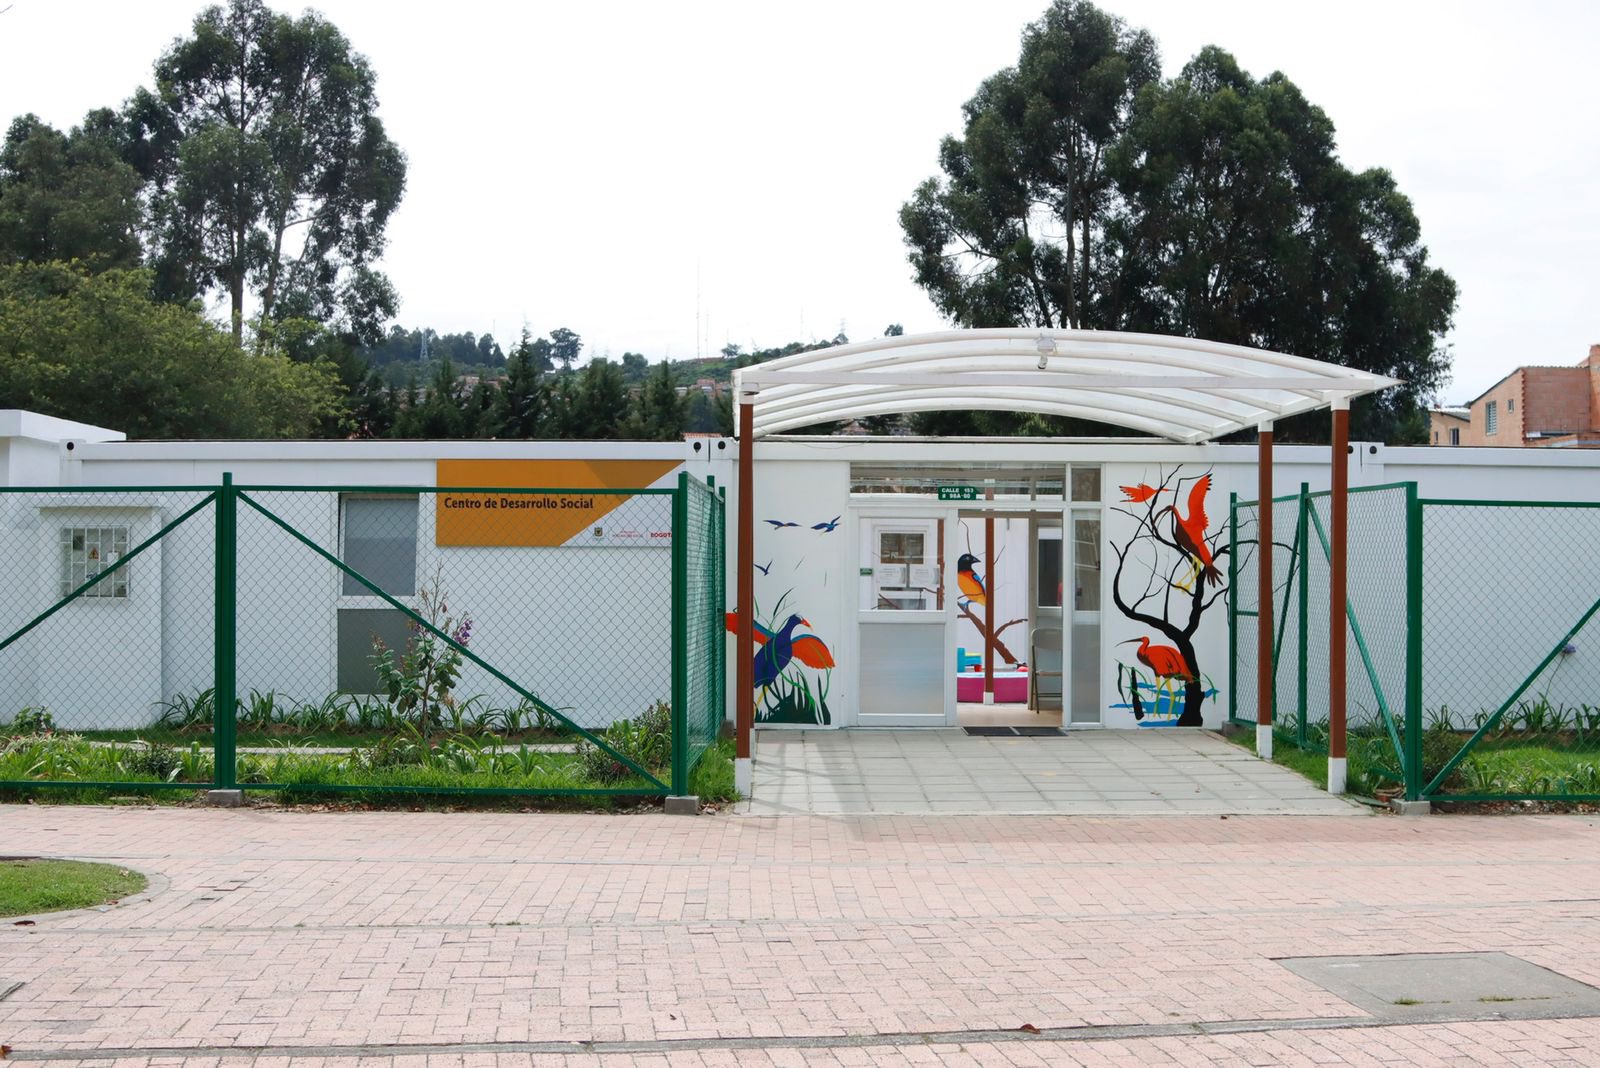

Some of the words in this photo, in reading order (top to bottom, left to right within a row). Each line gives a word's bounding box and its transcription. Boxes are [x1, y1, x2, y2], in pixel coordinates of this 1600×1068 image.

[444, 497, 481, 509] Centro
[484, 497, 497, 509] de
[500, 497, 558, 509] Desarrollo
[560, 497, 594, 509] Social
